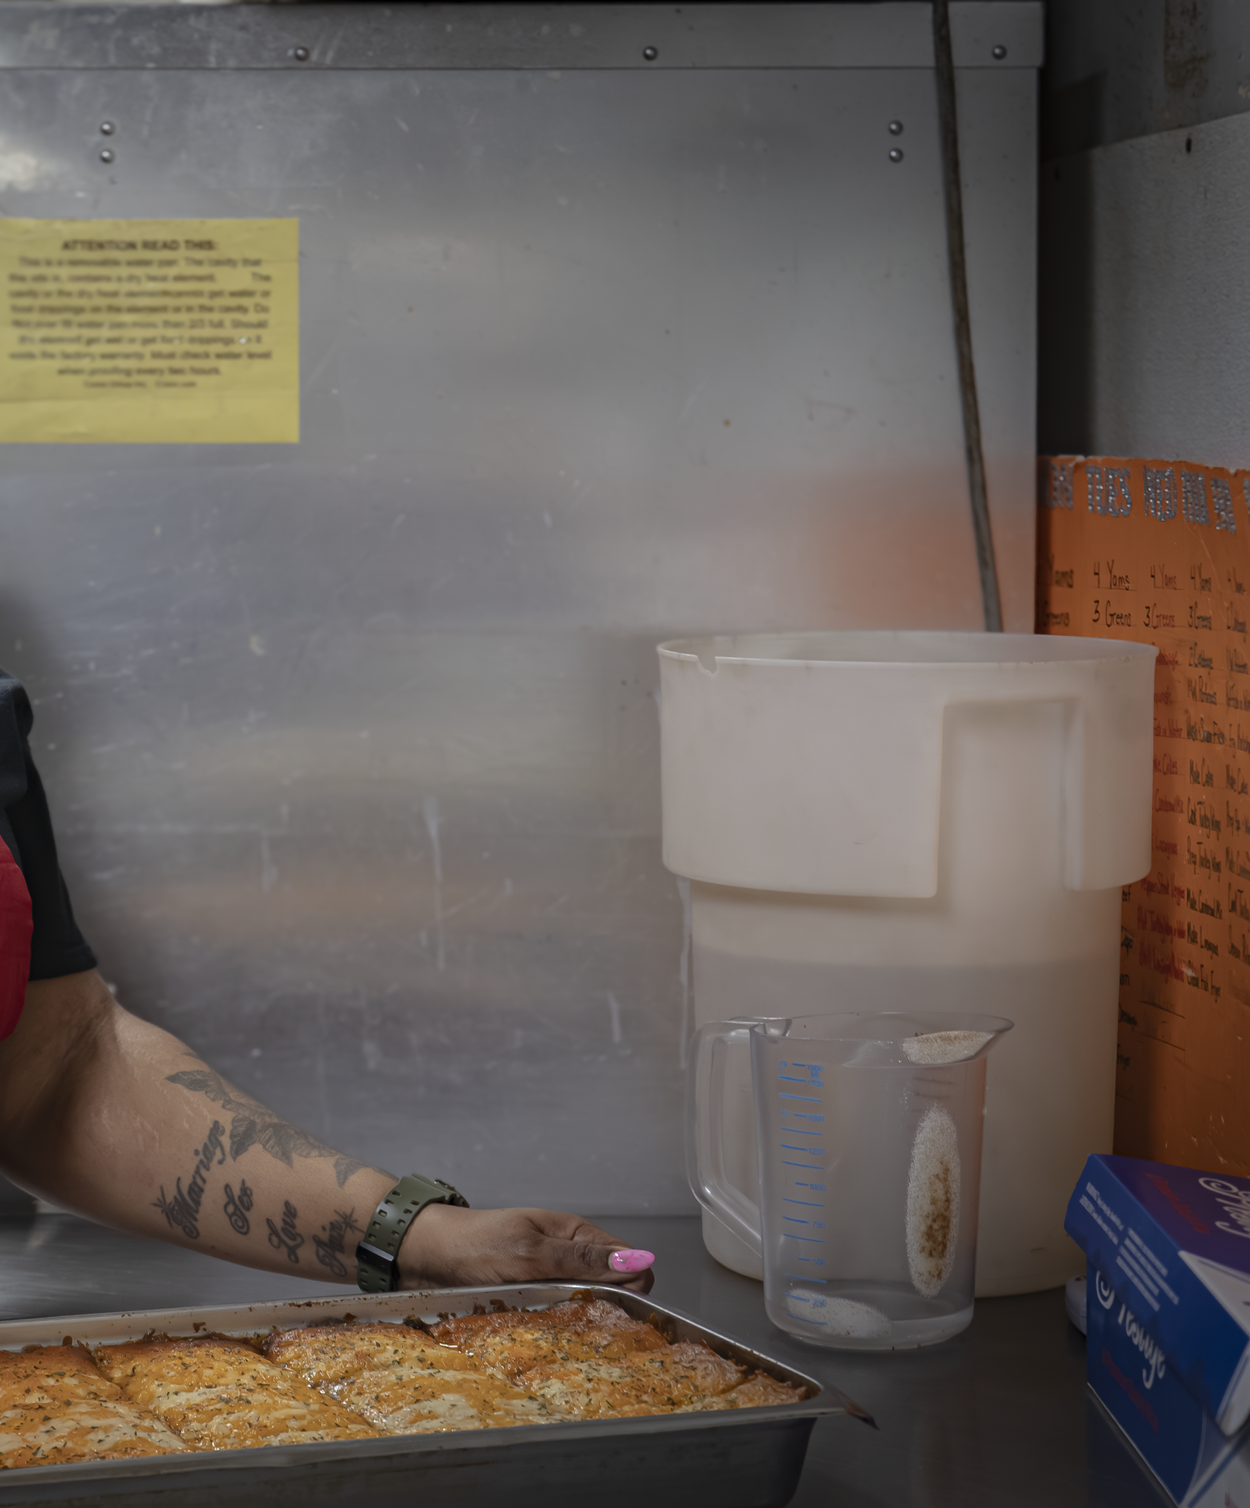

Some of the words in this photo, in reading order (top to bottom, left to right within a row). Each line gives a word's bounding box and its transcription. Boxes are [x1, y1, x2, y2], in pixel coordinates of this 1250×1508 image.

[60, 240, 138, 251] ATTENTION
[142, 240, 180, 251] READ
[1085, 466, 1133, 518] TUES
[1143, 465, 1177, 522] WED
[1093, 561, 1100, 587] 4
[1106, 559, 1131, 591] Yams
[1150, 564, 1156, 588] 4
[1159, 563, 1177, 590] Yams
[1092, 600, 1100, 623] 3
[1105, 602, 1132, 627] Greens
[1143, 605, 1151, 627] 3
[1152, 602, 1175, 629] Greens
[1188, 605, 1193, 628] 3
[170, 1120, 226, 1239] Marriage
[223, 1179, 253, 1236] Sex
[266, 1200, 305, 1264] Love
[312, 1219, 348, 1277] Pain
[812, 1298, 827, 1308] 250
